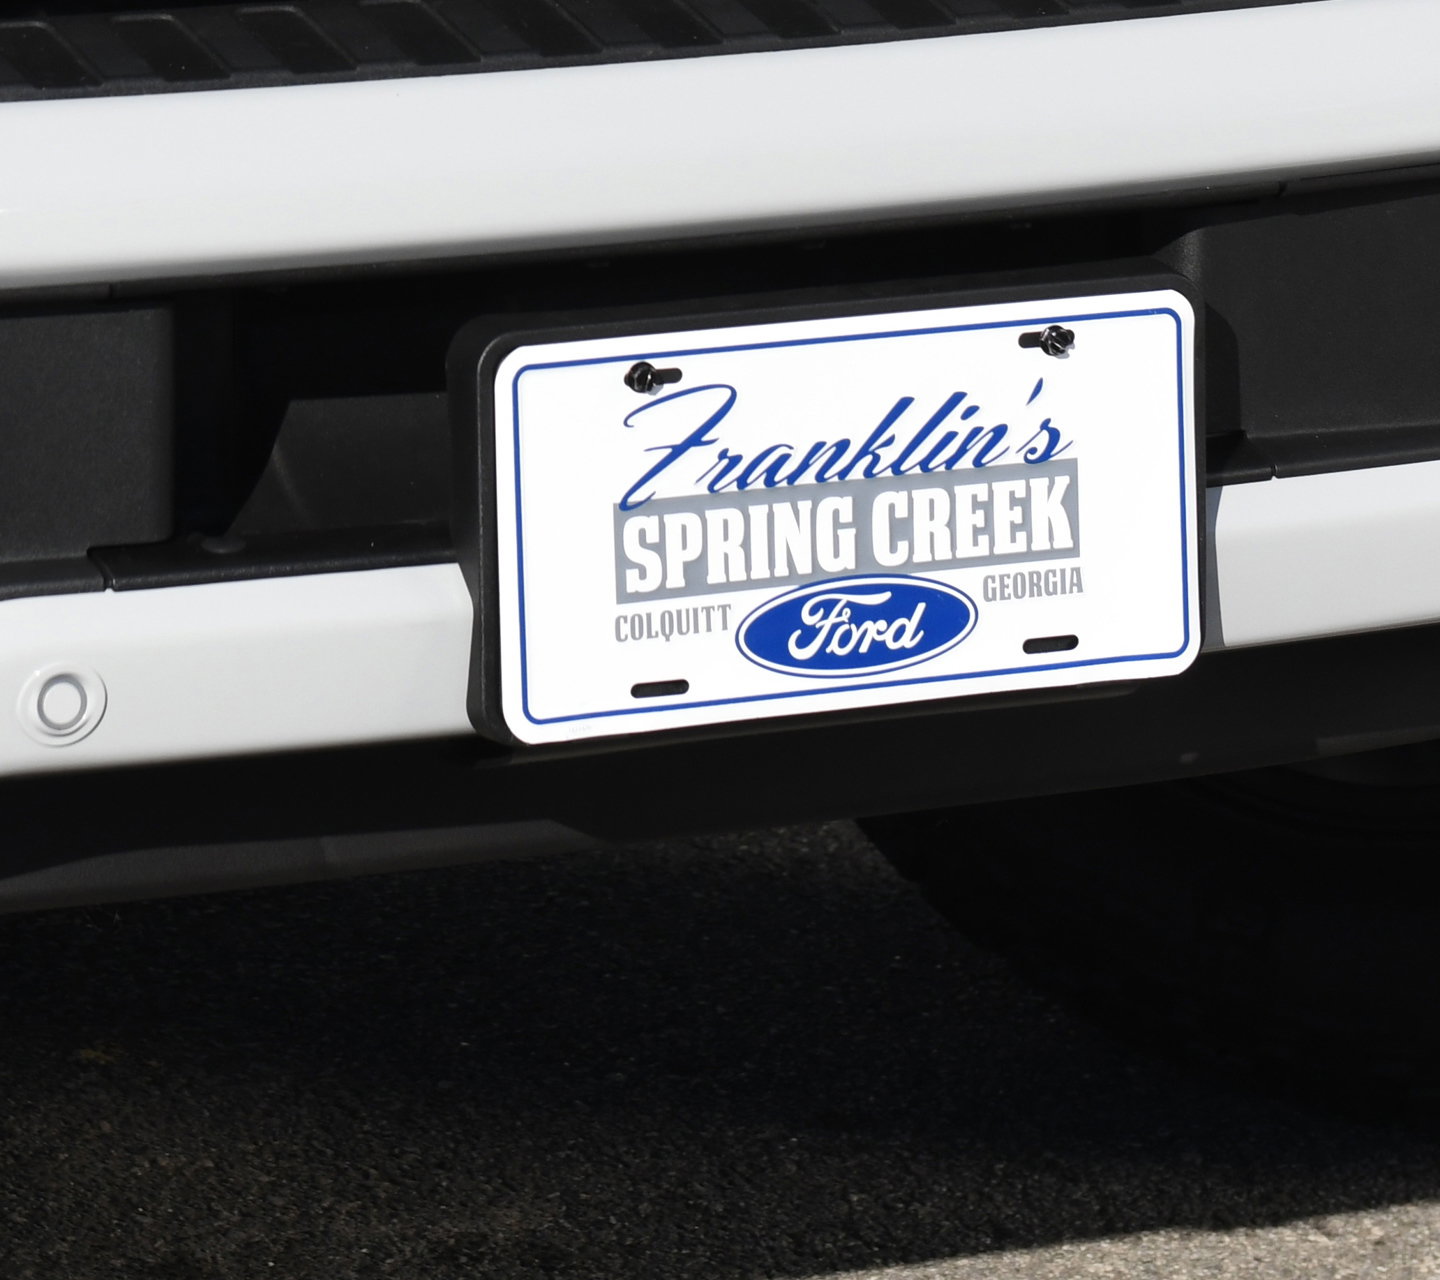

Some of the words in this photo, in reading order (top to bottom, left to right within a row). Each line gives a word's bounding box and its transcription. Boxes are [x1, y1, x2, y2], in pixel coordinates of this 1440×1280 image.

[618, 377, 1077, 512] Franklin's
[621, 496, 858, 595] SPRING
[870, 474, 1076, 564] CREEK
[614, 602, 733, 644] COLQUITT
[786, 590, 926, 660] Ford
[981, 566, 1085, 604] GEORGIA
